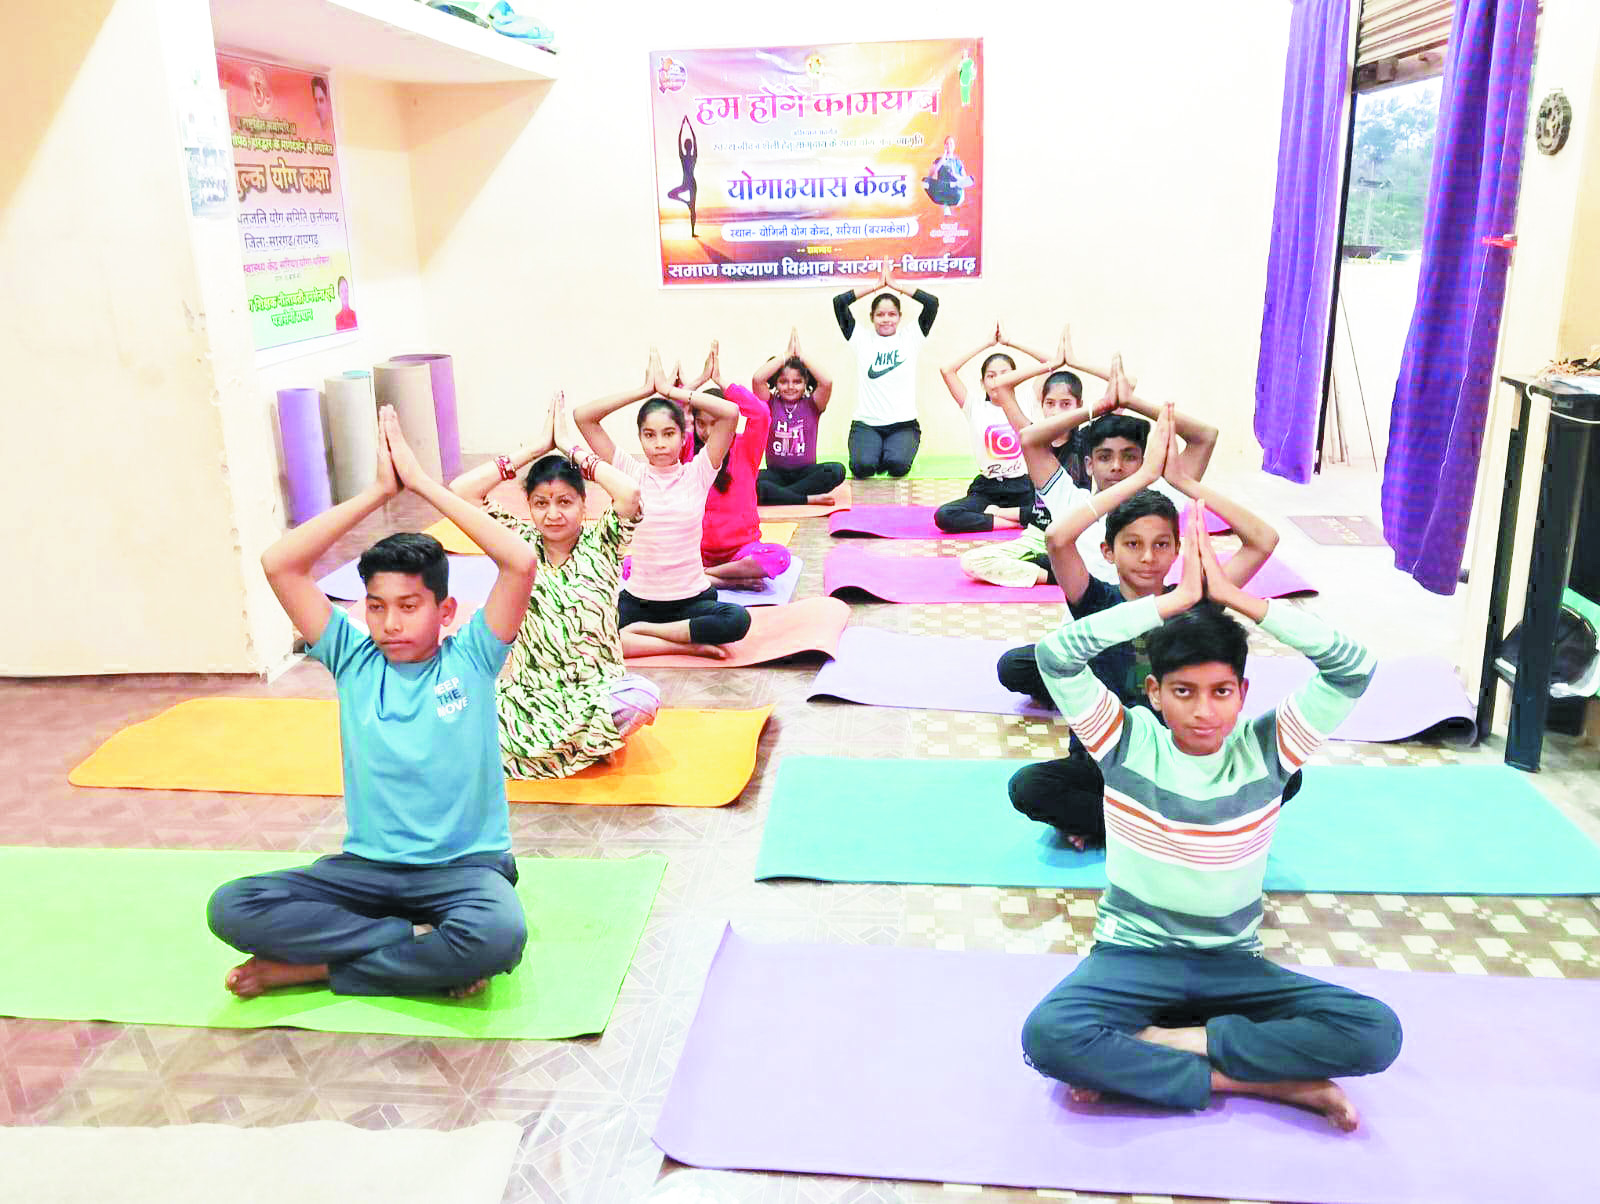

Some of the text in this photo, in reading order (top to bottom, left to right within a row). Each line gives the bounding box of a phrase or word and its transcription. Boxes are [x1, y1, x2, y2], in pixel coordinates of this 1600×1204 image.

[695, 96, 739, 126] हम
[270, 156, 301, 193] योग
[302, 166, 332, 194] कक्षा
[727, 166, 908, 201] योगाभ्यास केन्द्र
[269, 208, 283, 224] योग
[668, 263, 719, 278] समाज
[721, 262, 778, 277] कल्याण
[780, 256, 834, 276] विभाग
[874, 349, 900, 367] NIKE
[436, 688, 461, 705] THE
